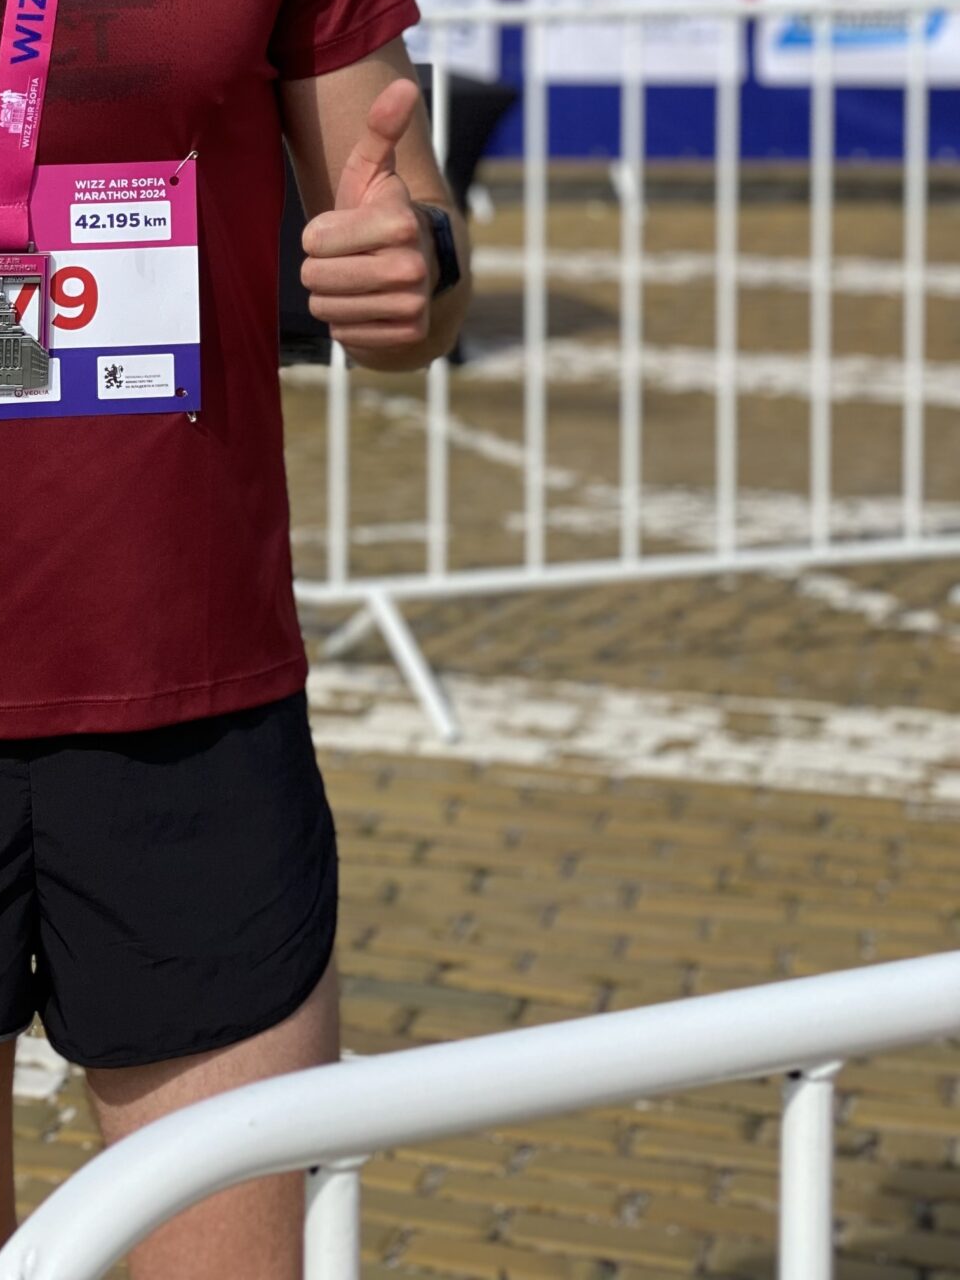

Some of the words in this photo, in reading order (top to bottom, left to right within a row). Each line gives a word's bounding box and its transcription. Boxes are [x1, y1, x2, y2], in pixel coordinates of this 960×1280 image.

[29, 78, 39, 105] SOFIA
[27, 105, 35, 123] AIR
[22, 124, 32, 148] WIZZ
[75, 180, 105, 189] WIZZ
[109, 179, 128, 188] AIR
[132, 177, 166, 187] SOFIA
[75, 190, 137, 201] MARATHON
[140, 189, 167, 199] 2024
[75, 213, 141, 229] 42.195
[144, 215, 167, 227] km
